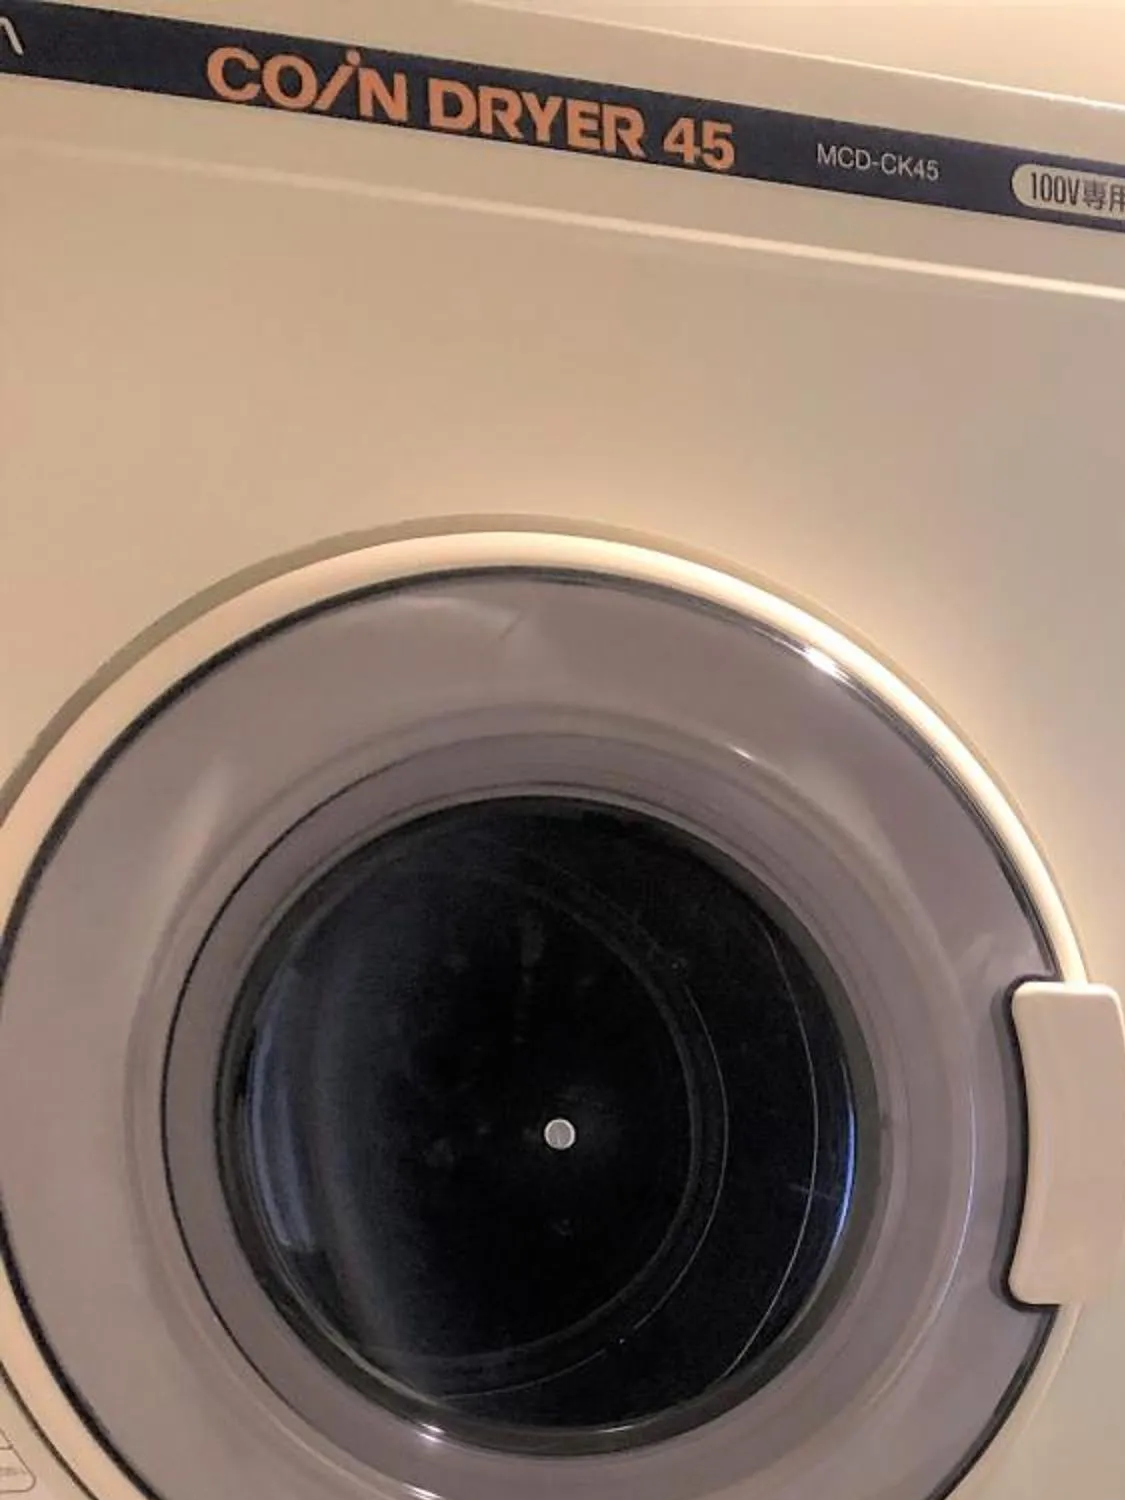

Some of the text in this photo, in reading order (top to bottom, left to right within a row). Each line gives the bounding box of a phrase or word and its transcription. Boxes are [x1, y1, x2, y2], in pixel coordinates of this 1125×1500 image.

[207, 46, 735, 170] COIN DRYER 45
[817, 143, 940, 182] MCD-CK45
